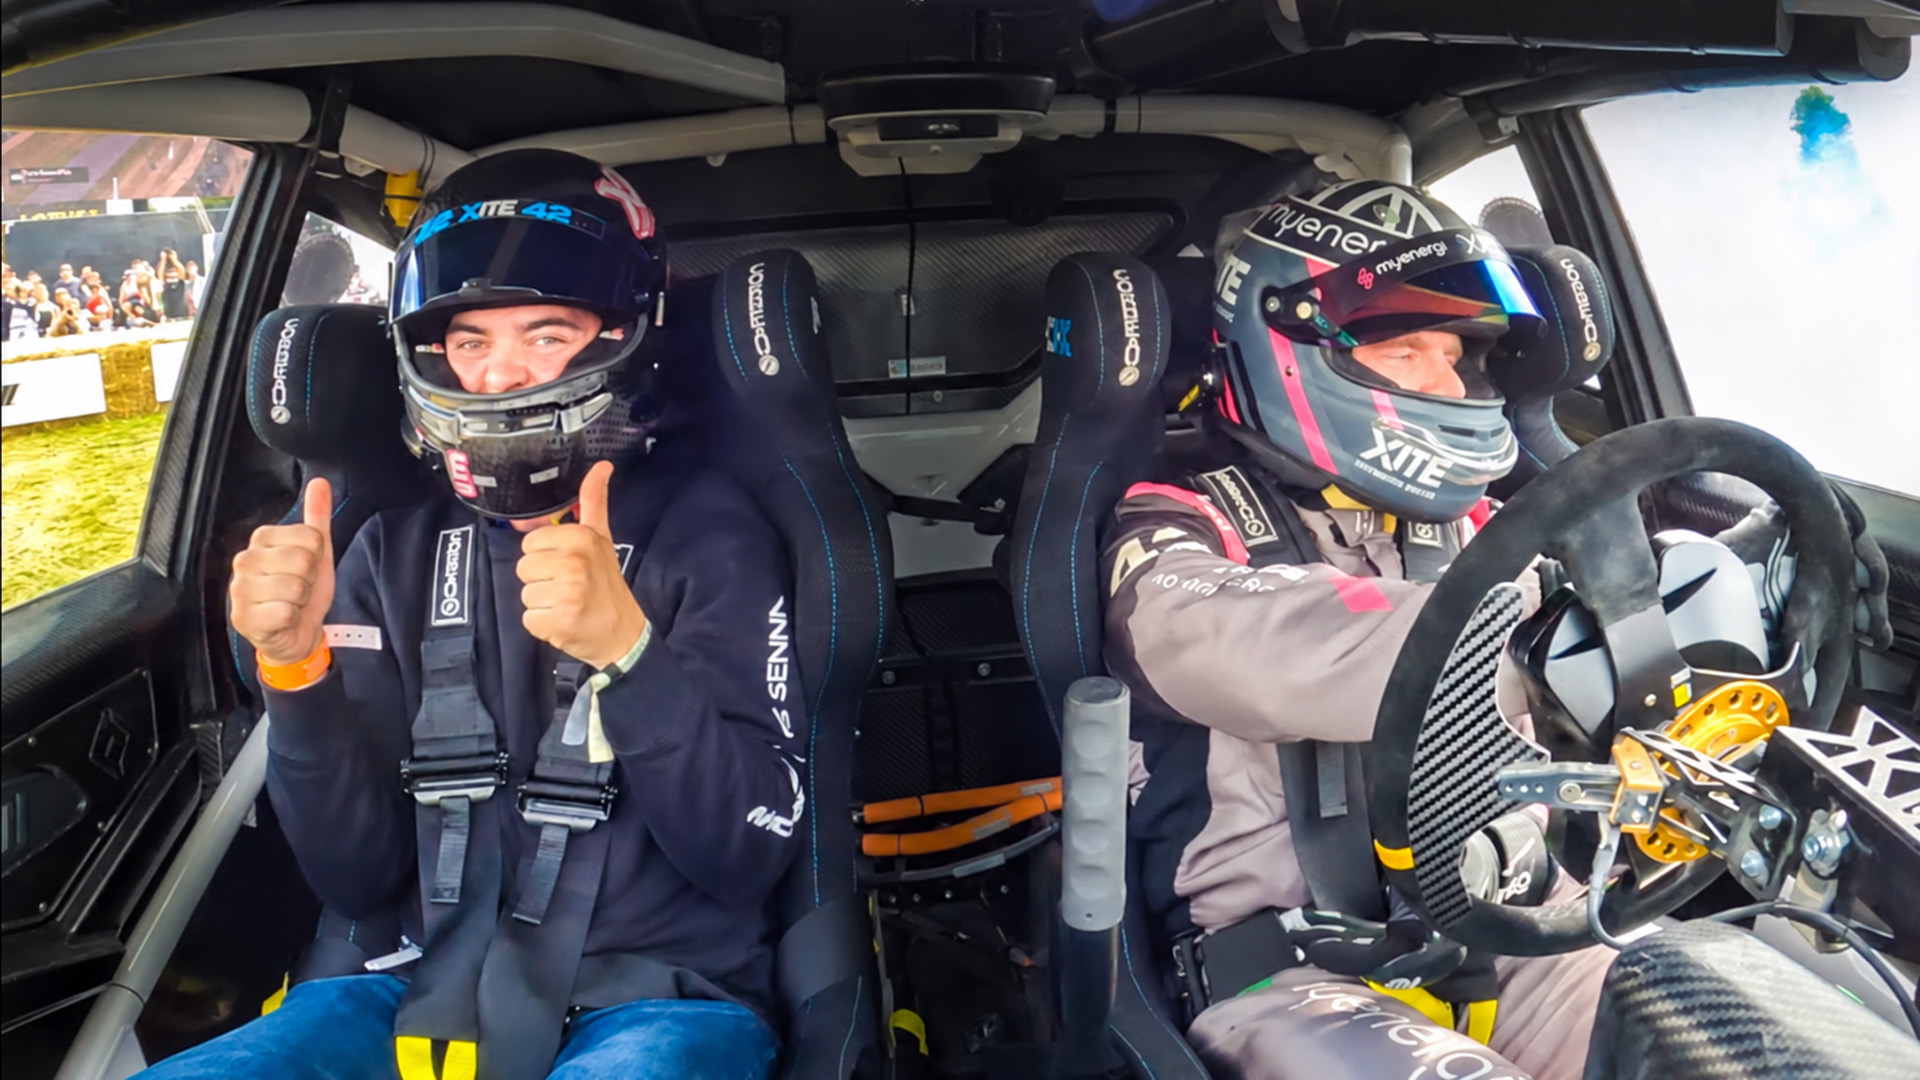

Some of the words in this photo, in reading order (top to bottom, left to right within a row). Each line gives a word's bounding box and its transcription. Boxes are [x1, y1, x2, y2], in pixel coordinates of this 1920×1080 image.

[457, 199, 519, 223] XITE
[521, 201, 573, 226] 42
[1375, 240, 1449, 276] myenergi
[1360, 427, 1455, 489] XITE
